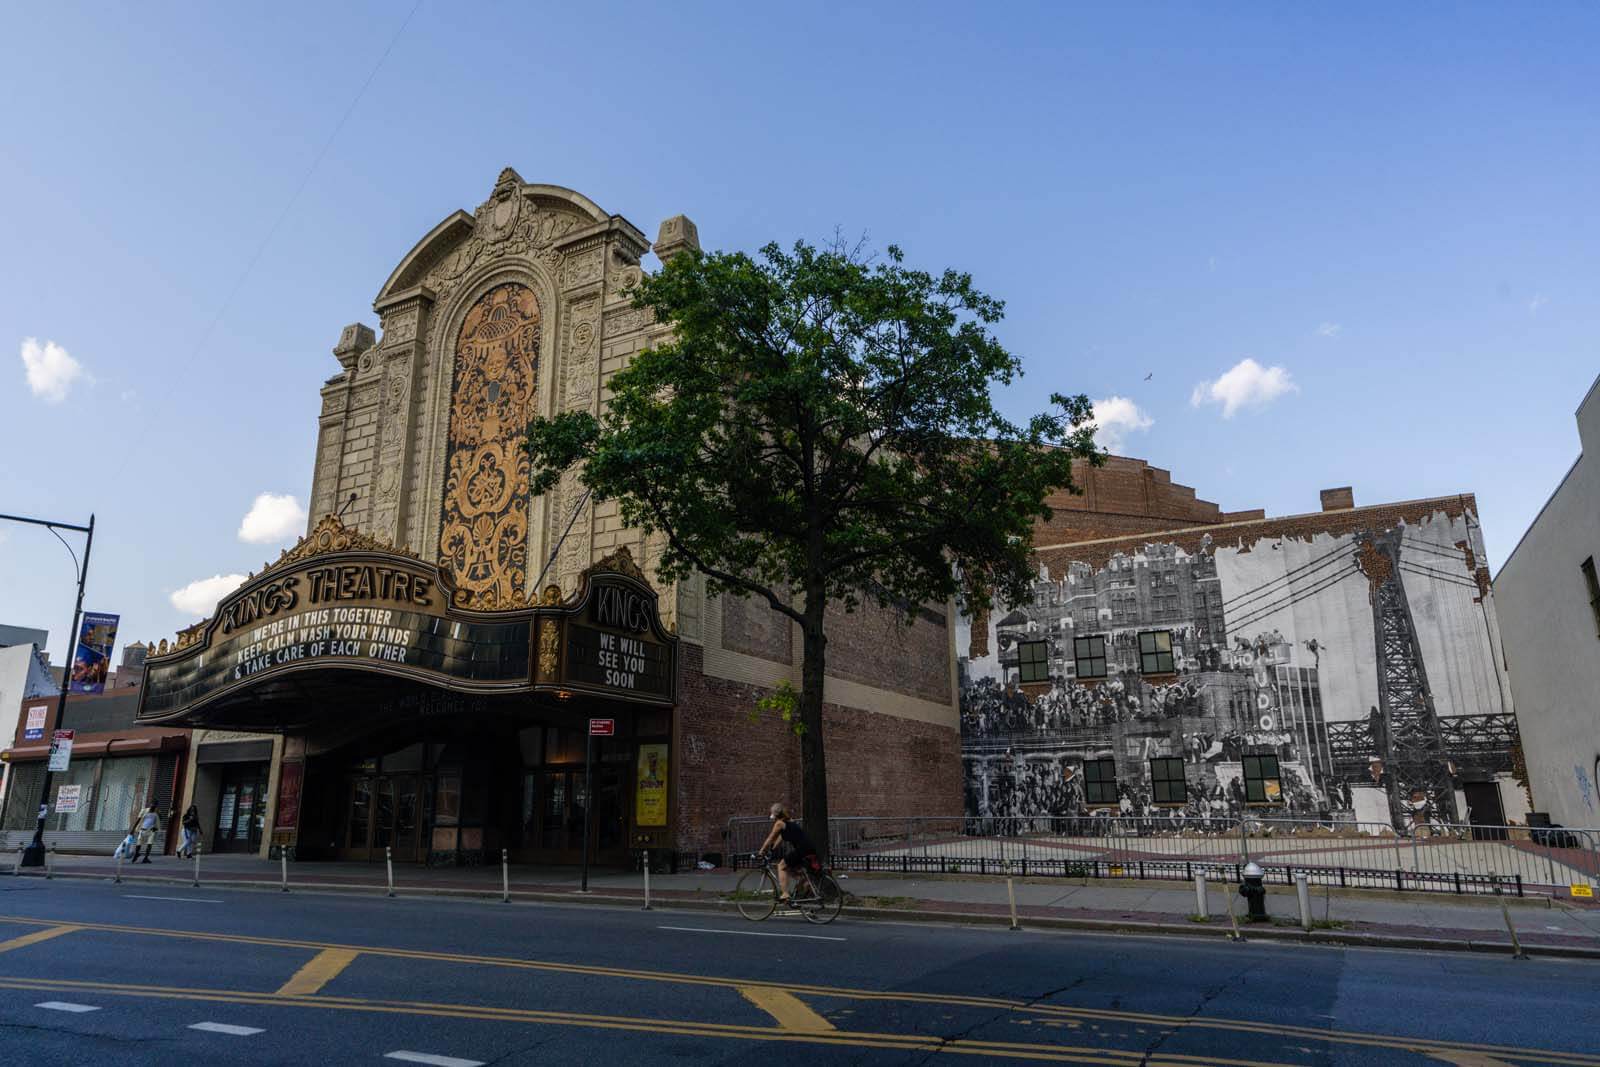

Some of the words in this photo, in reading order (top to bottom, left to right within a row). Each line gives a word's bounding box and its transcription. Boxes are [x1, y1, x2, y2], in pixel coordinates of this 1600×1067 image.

[223, 577, 299, 633] KINGS
[308, 567, 432, 604] THEATRE
[598, 587, 650, 632] KINGS
[254, 620, 284, 642] WE'RE
[288, 614, 300, 631] IN
[304, 610, 329, 626] THIS
[333, 608, 392, 625] TOGETHER
[234, 665, 242, 679] &
[244, 654, 271, 675] TAKE
[276, 644, 305, 663] CARE
[310, 641, 325, 657] OF
[330, 641, 361, 656] EACH
[368, 643, 407, 663] OTHER
[237, 642, 263, 664] KEEP
[266, 631, 295, 652] CALM
[300, 625, 330, 643] WASH
[336, 624, 368, 640] YOUR
[371, 626, 411, 646] HANDS
[598, 650, 618, 668] SEE
[623, 655, 645, 673] YOU
[600, 632, 616, 650] WE
[620, 637, 645, 657] WILL
[605, 670, 635, 689] SOON
